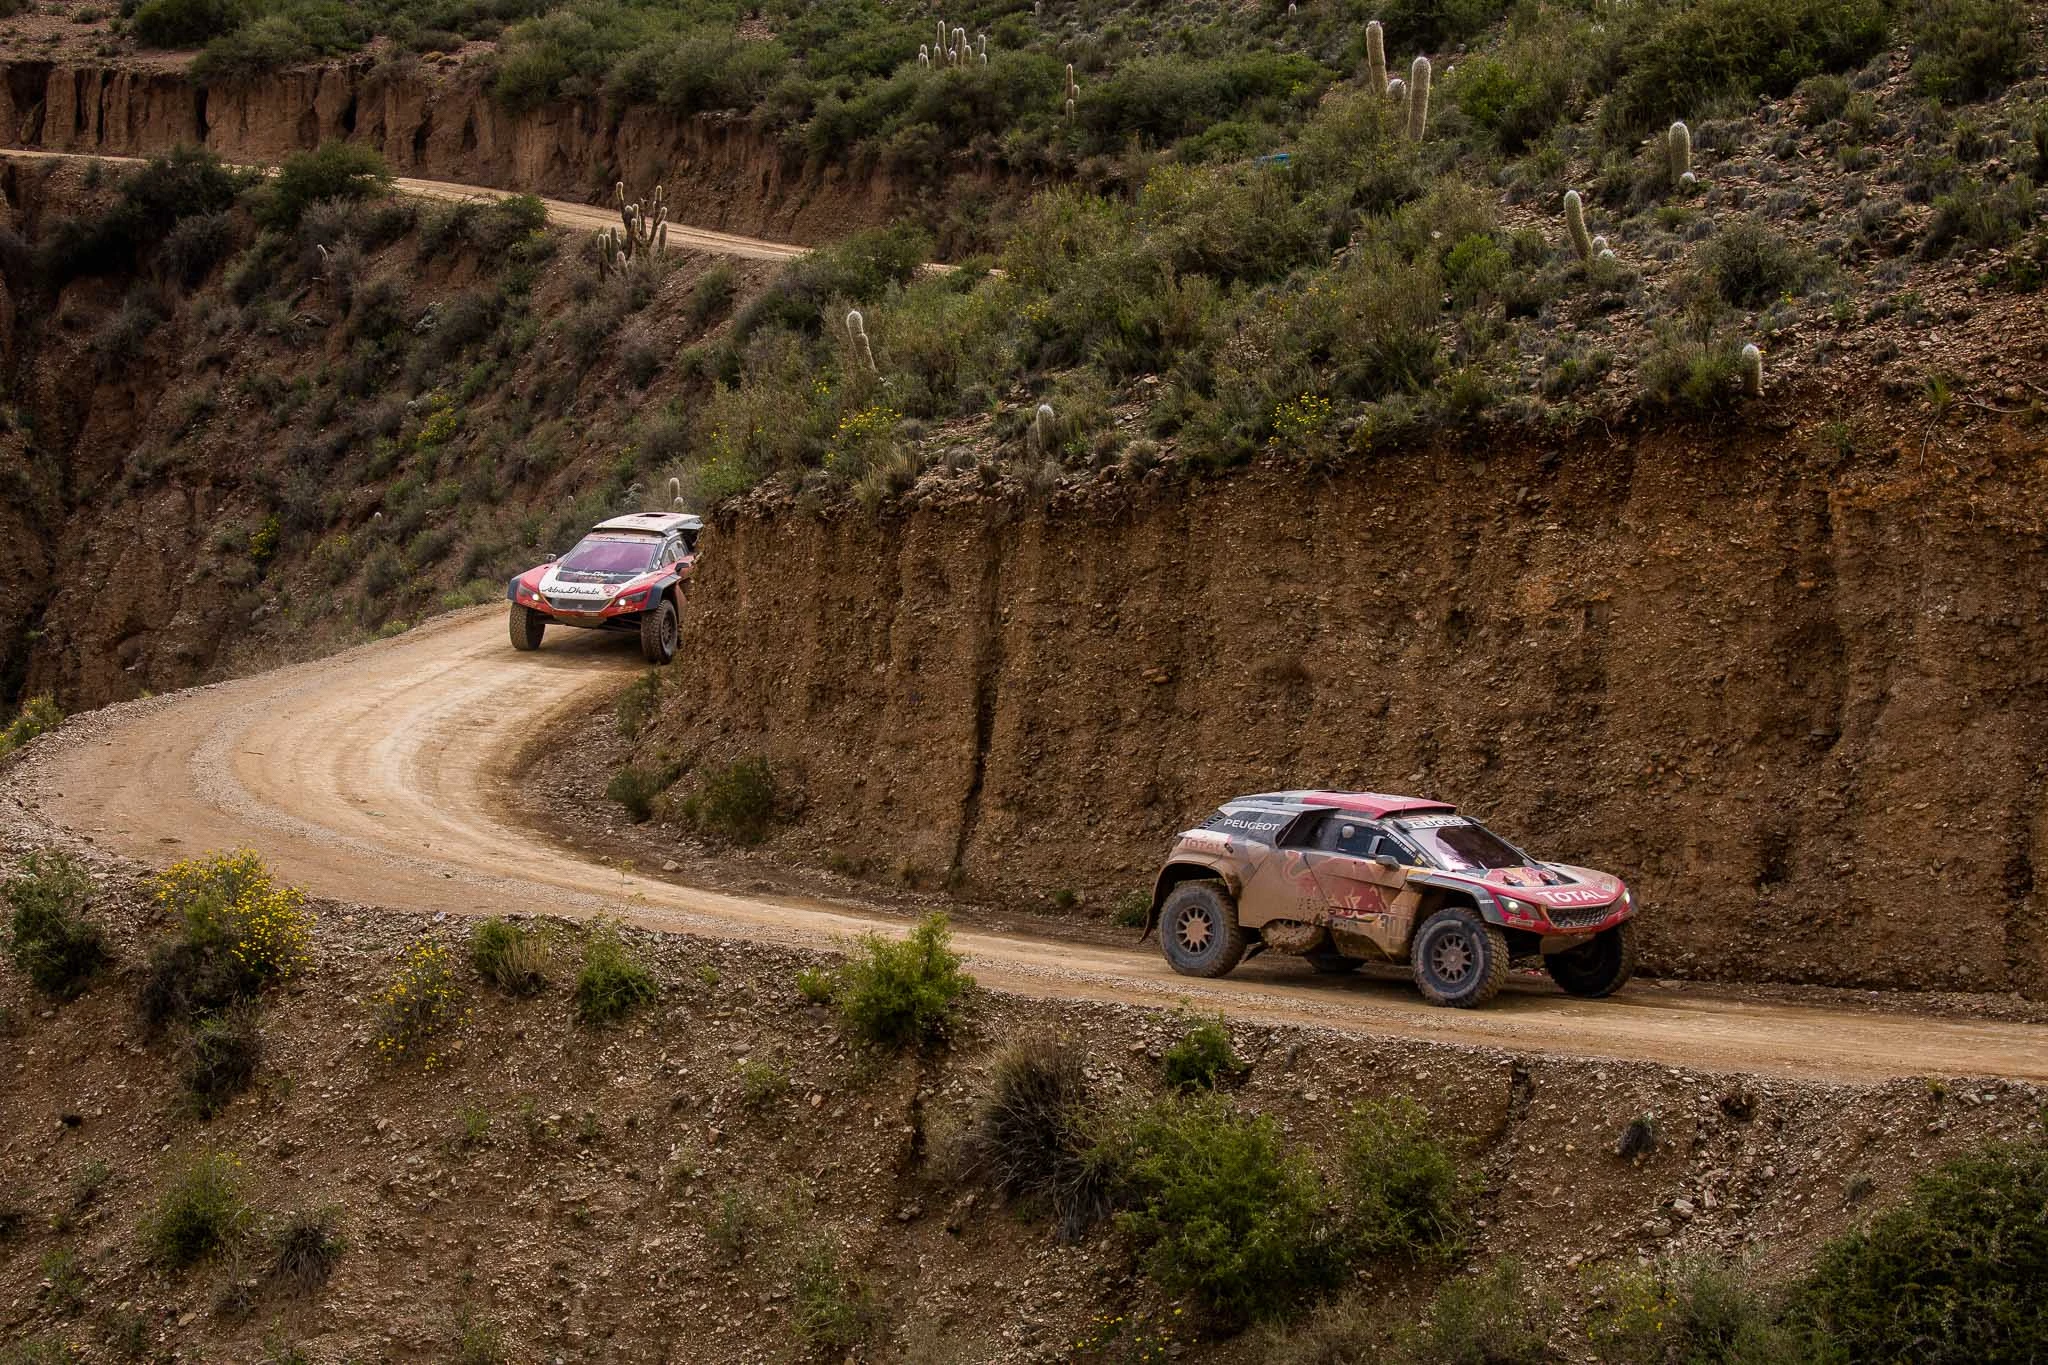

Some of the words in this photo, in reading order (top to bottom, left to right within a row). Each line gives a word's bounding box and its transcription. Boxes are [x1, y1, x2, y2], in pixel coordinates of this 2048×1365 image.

[542, 586, 566, 594] Abu
[567, 587, 600, 595] Dhabi
[1224, 819, 1280, 831] PEUGEOT
[1536, 891, 1608, 903] TOTAL
